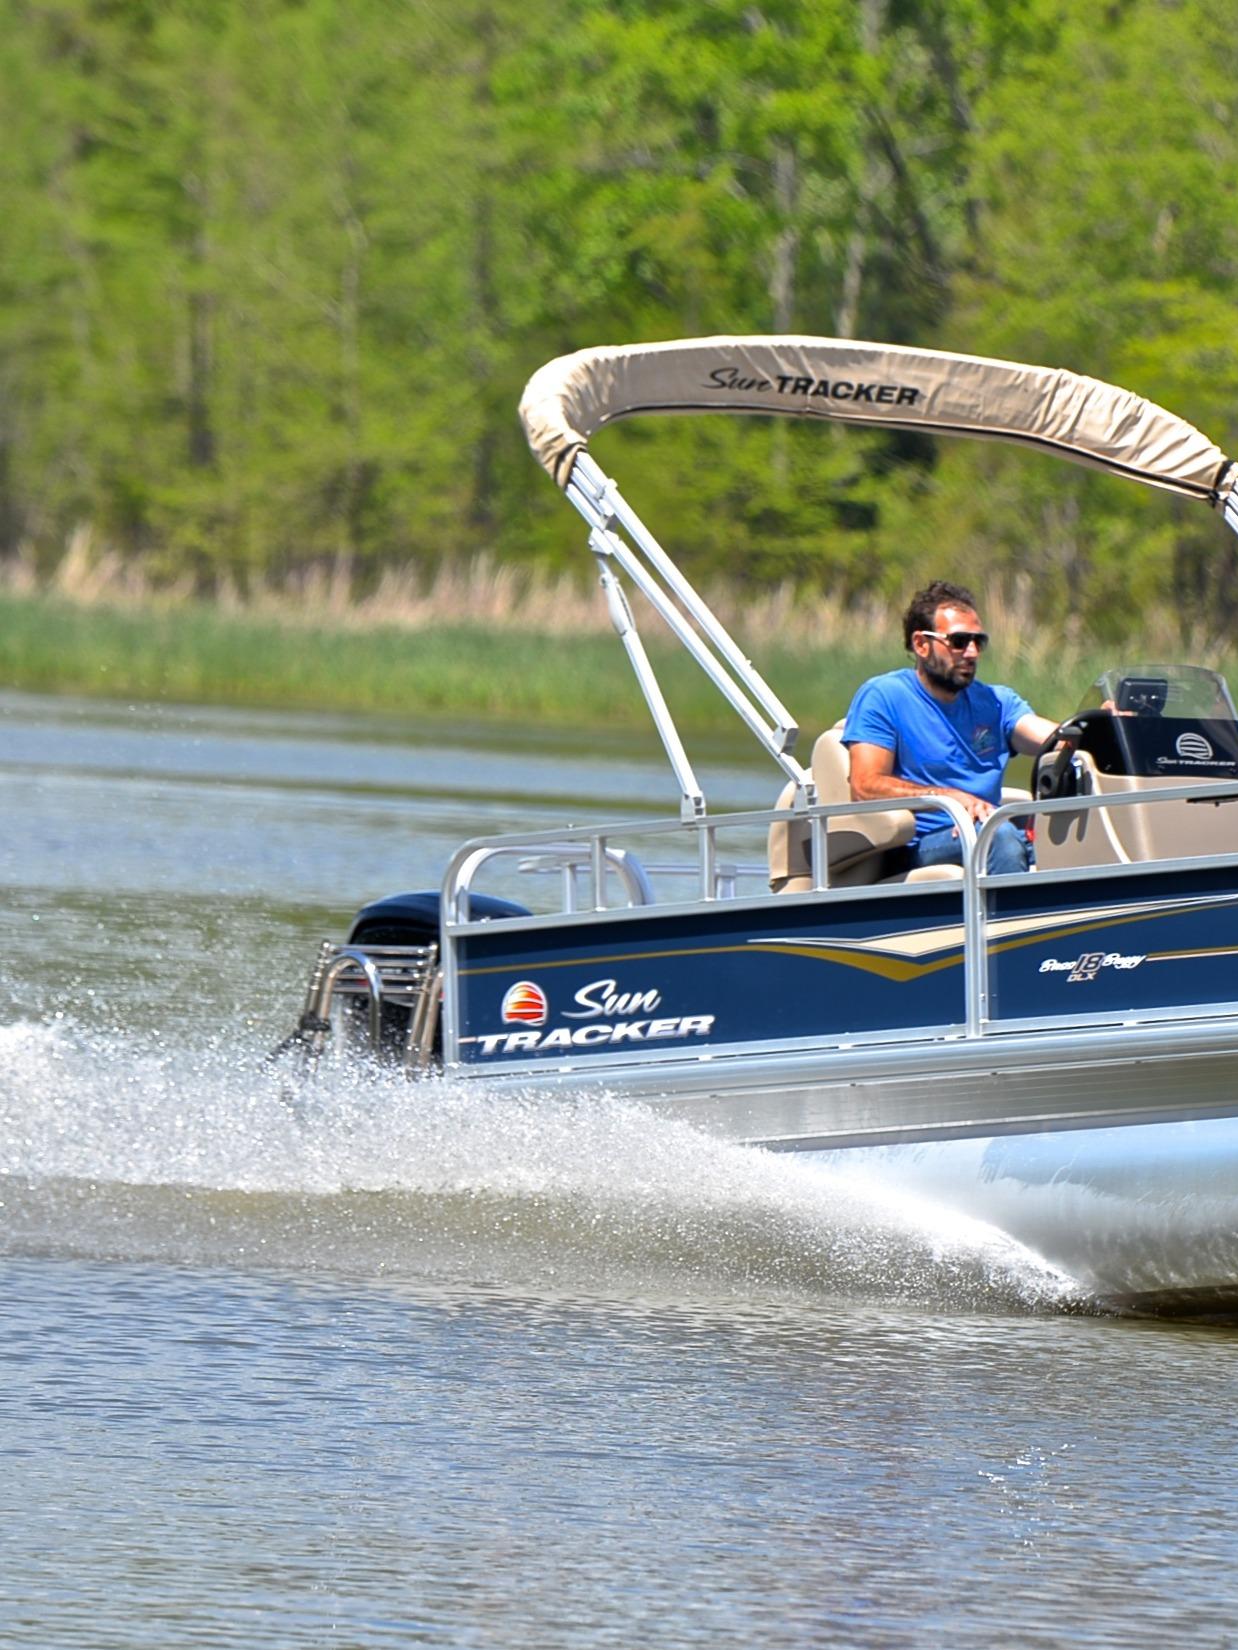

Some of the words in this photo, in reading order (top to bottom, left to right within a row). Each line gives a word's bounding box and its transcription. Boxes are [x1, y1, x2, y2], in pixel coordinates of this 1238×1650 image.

[701, 366, 772, 393] Sun
[776, 375, 920, 406] TRACKER
[1179, 759, 1236, 767] TRACKER
[1066, 972, 1097, 982] DLX
[1072, 952, 1106, 974] 18
[560, 978, 662, 1019] Sun
[477, 1015, 716, 1056] TRACKER
